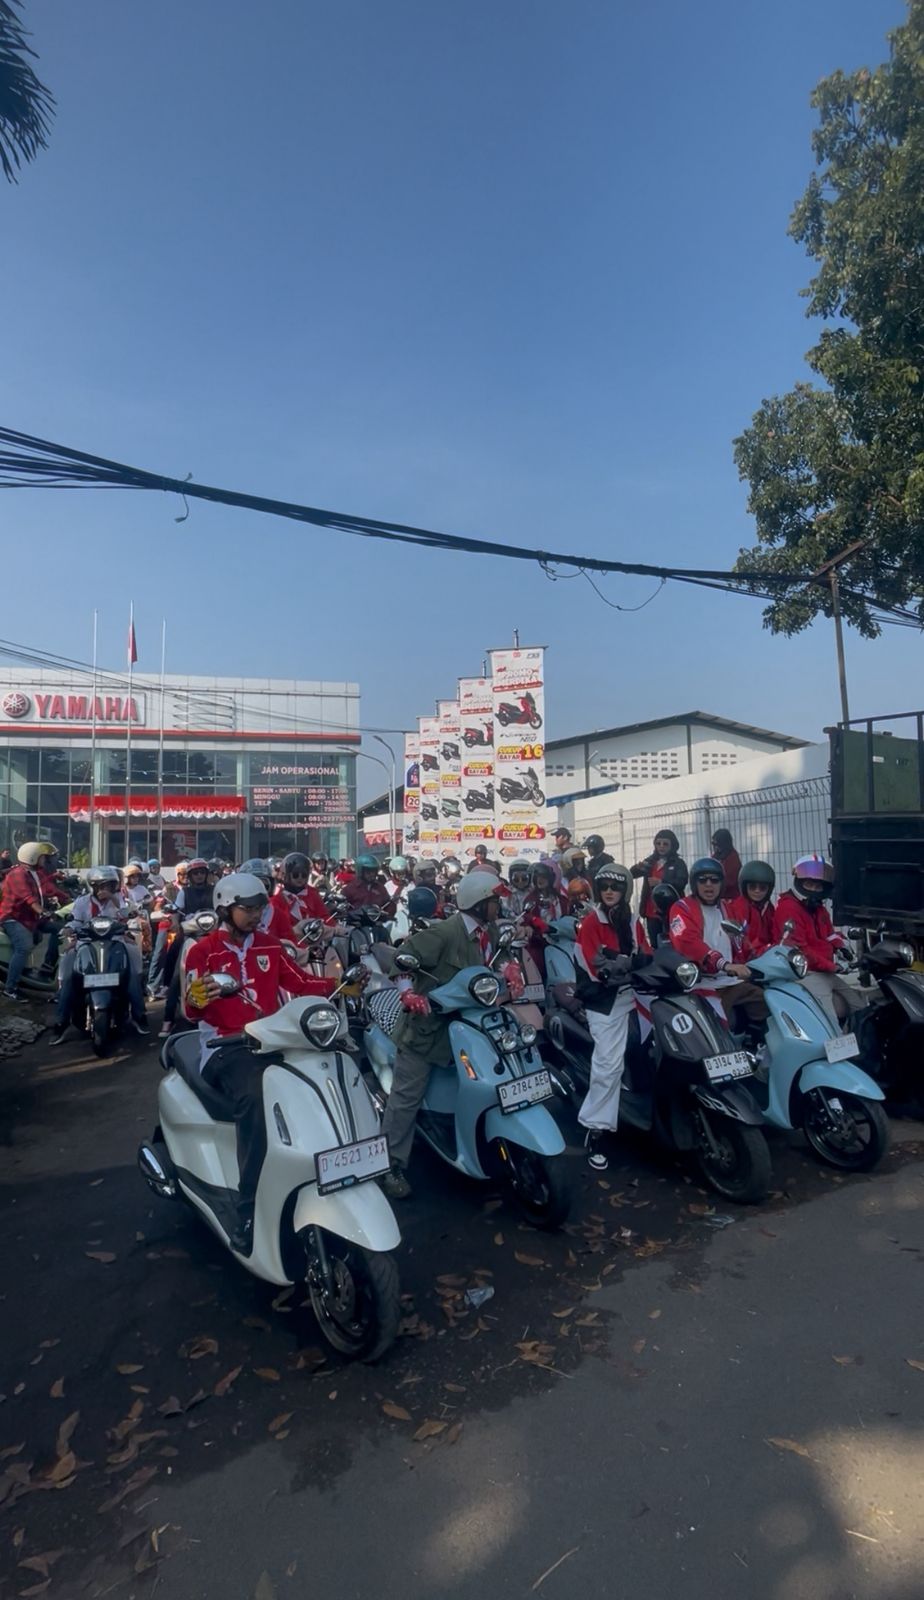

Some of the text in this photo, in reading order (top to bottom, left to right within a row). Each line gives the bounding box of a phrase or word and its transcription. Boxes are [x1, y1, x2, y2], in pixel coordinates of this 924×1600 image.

[35, 694, 138, 721] YAMAHA
[524, 745, 544, 758] 16
[281, 767, 340, 775] OPERASIONAL
[530, 825, 538, 837] 2
[676, 1014, 689, 1032] 11
[706, 1060, 712, 1070] D
[713, 1056, 732, 1069] 3194
[501, 1088, 507, 1099] D
[511, 1079, 532, 1096] 2784
[322, 1141, 385, 1172] D 4521 XXX
